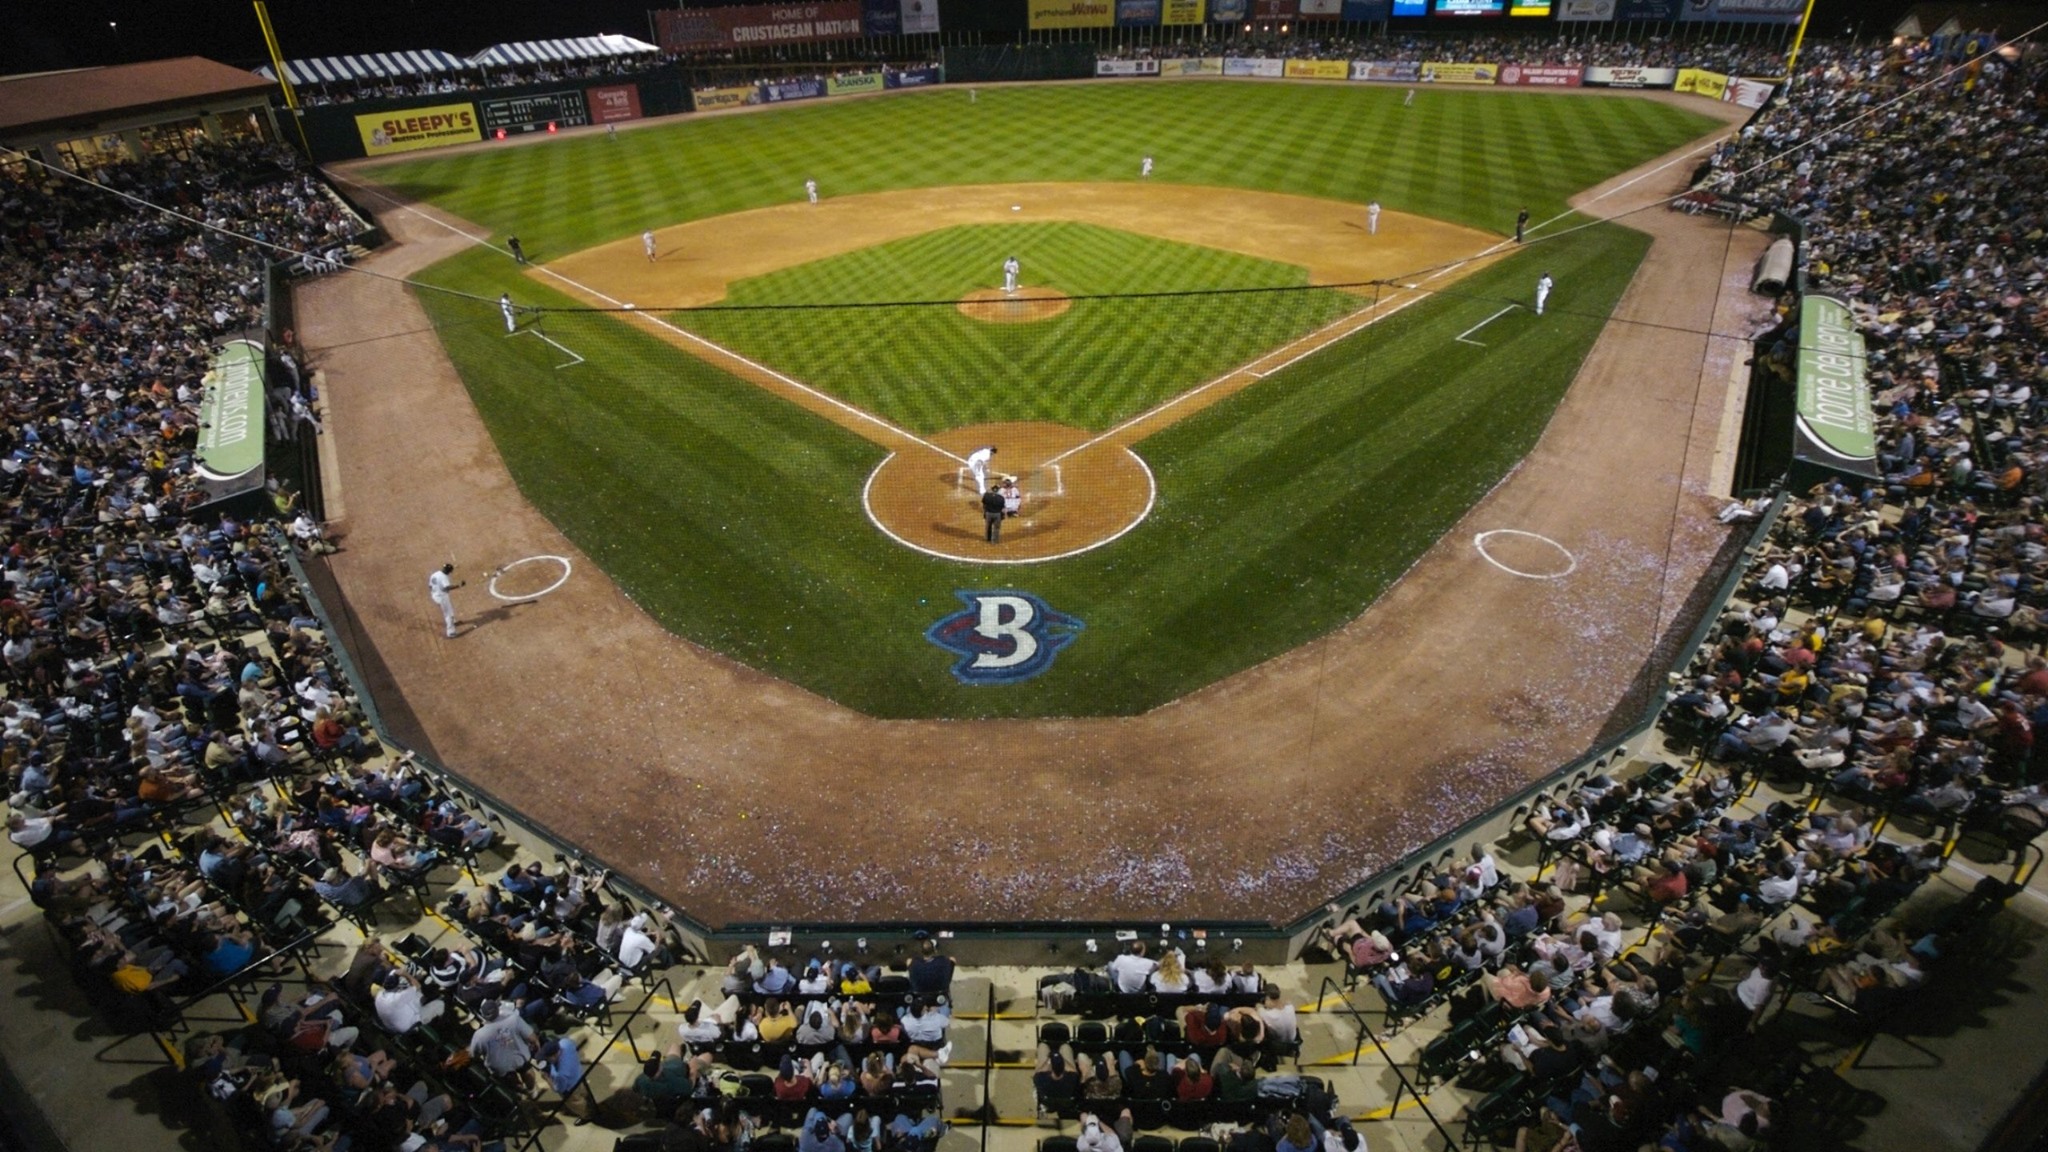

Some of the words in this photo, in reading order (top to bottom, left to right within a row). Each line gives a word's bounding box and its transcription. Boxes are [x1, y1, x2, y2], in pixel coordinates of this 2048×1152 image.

[772, 8, 804, 20] HOME
[805, 7, 819, 18] OF
[1072, 2, 1108, 16] Wawa
[732, 21, 813, 42] CRUSTACEAN
[815, 19, 860, 36] NATION
[382, 111, 472, 137] SLEEPY'S
[391, 134, 425, 143] Mattress
[427, 128, 474, 138] Professionals
[1805, 323, 1858, 377] delivery
[1803, 377, 1854, 431] home
[971, 595, 1038, 668] B
